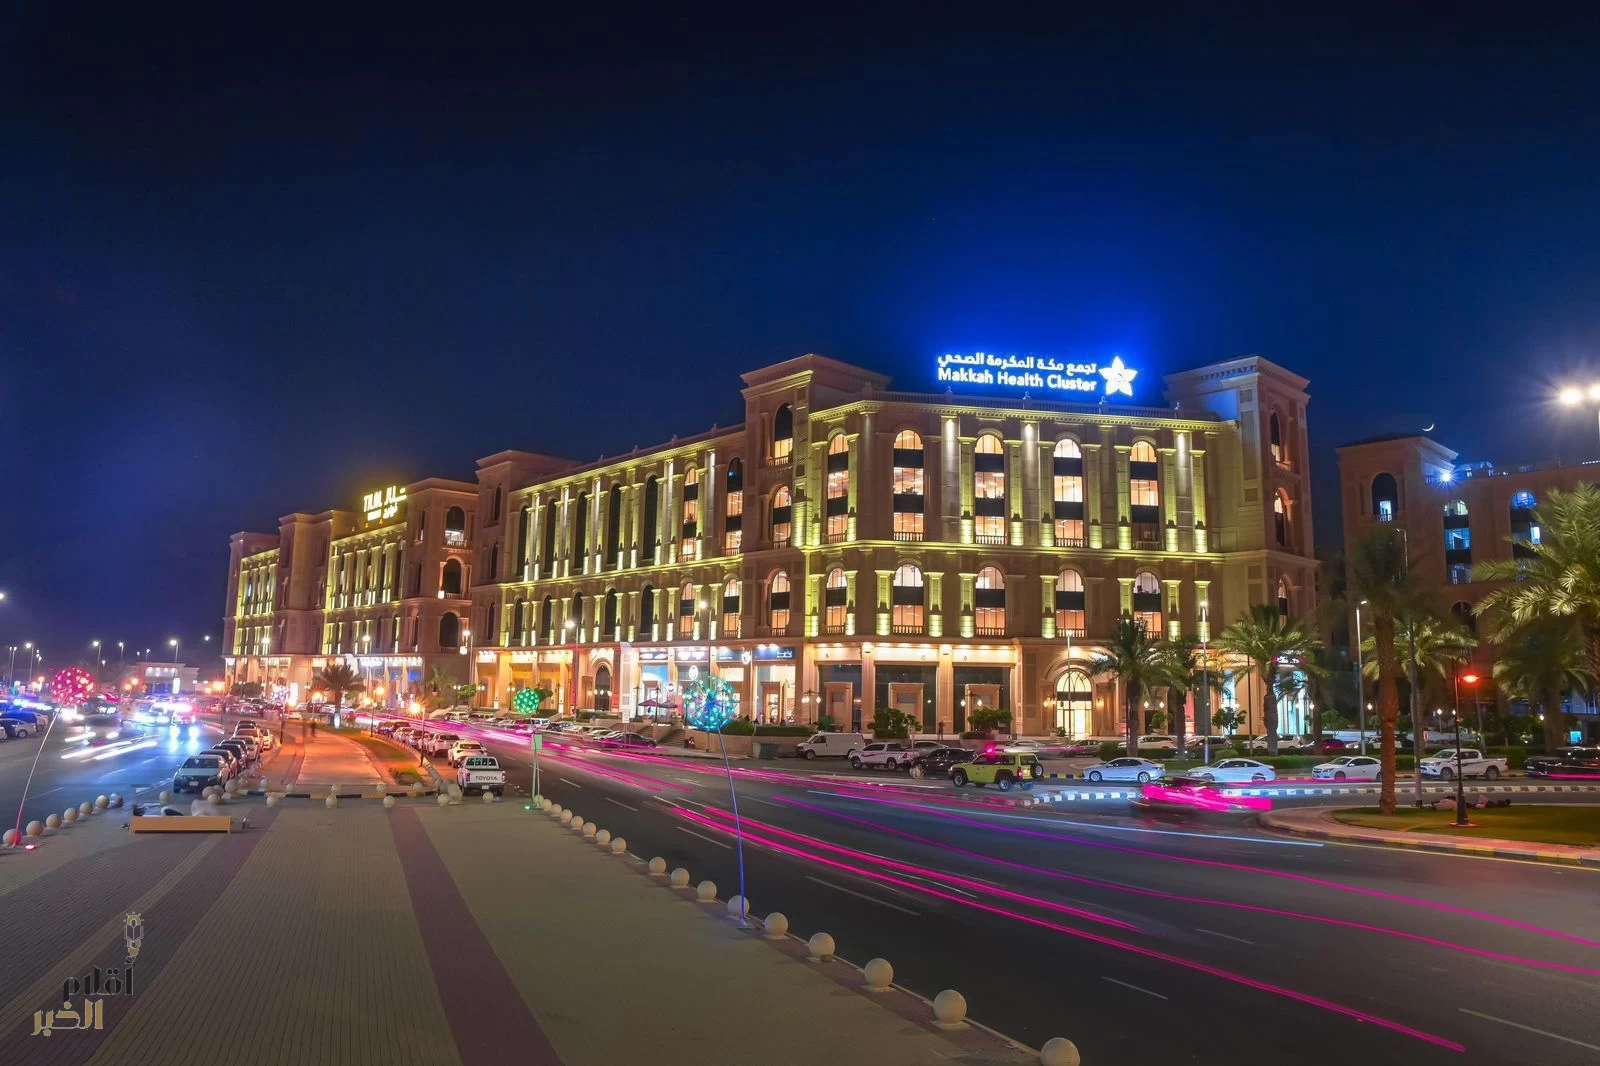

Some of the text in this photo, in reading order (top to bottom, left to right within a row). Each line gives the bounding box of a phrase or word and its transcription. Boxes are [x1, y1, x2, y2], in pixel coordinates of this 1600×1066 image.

[937, 352, 1097, 376] تجمع مكة المكرمة الصحي
[937, 367, 1097, 391] Makkah Health Cluster
